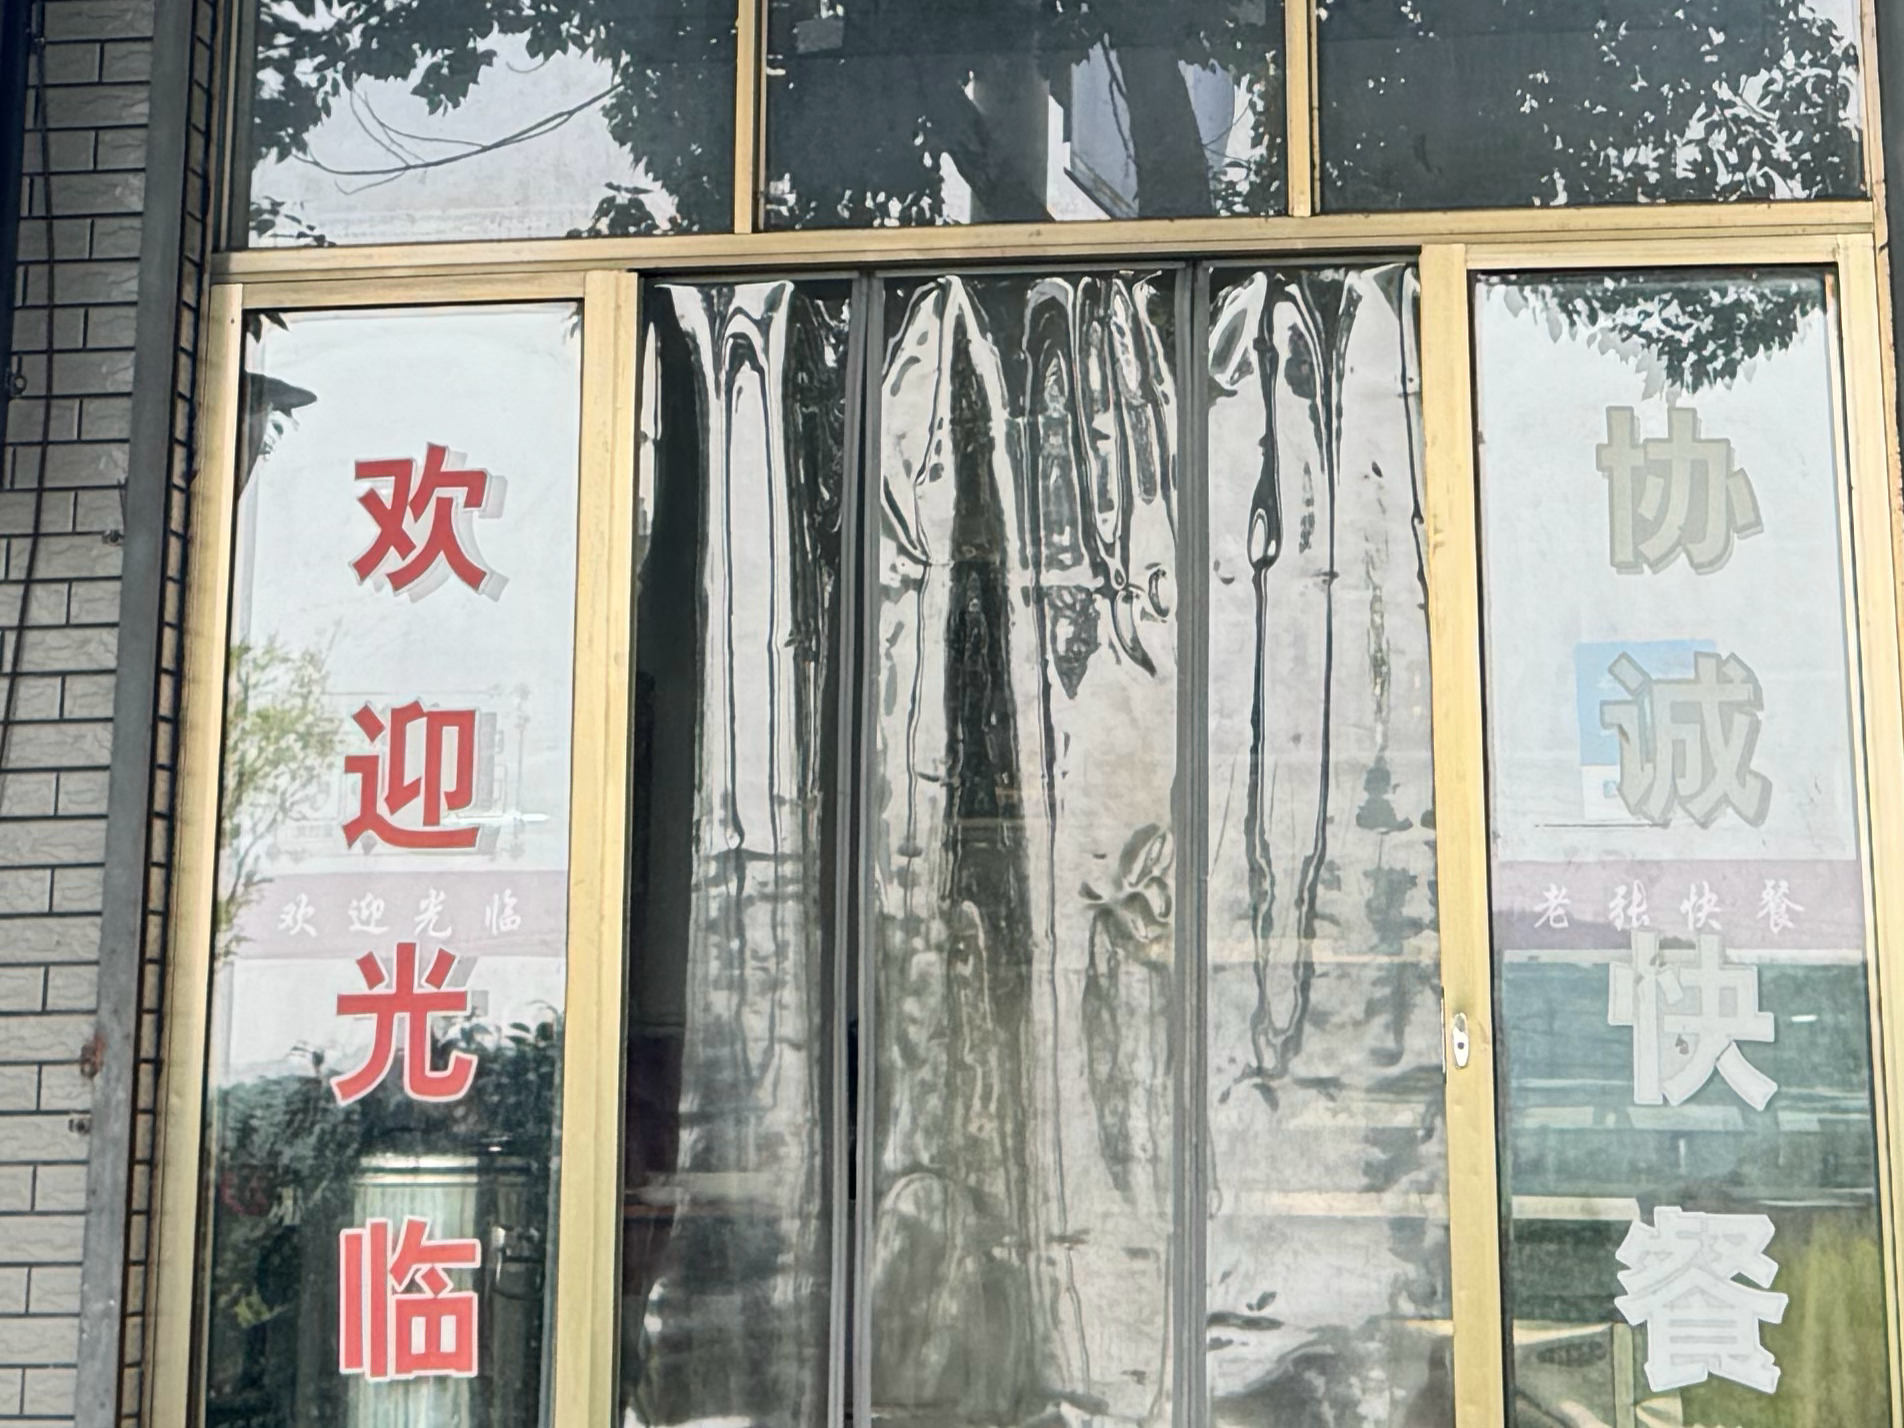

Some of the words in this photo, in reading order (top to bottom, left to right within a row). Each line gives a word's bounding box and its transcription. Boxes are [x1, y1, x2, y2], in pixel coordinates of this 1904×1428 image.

[278, 888, 522, 939] 欢迎光临
[332, 442, 488, 1380] 欢迎光临
[1597, 406, 1790, 1395] 协诚快餐
